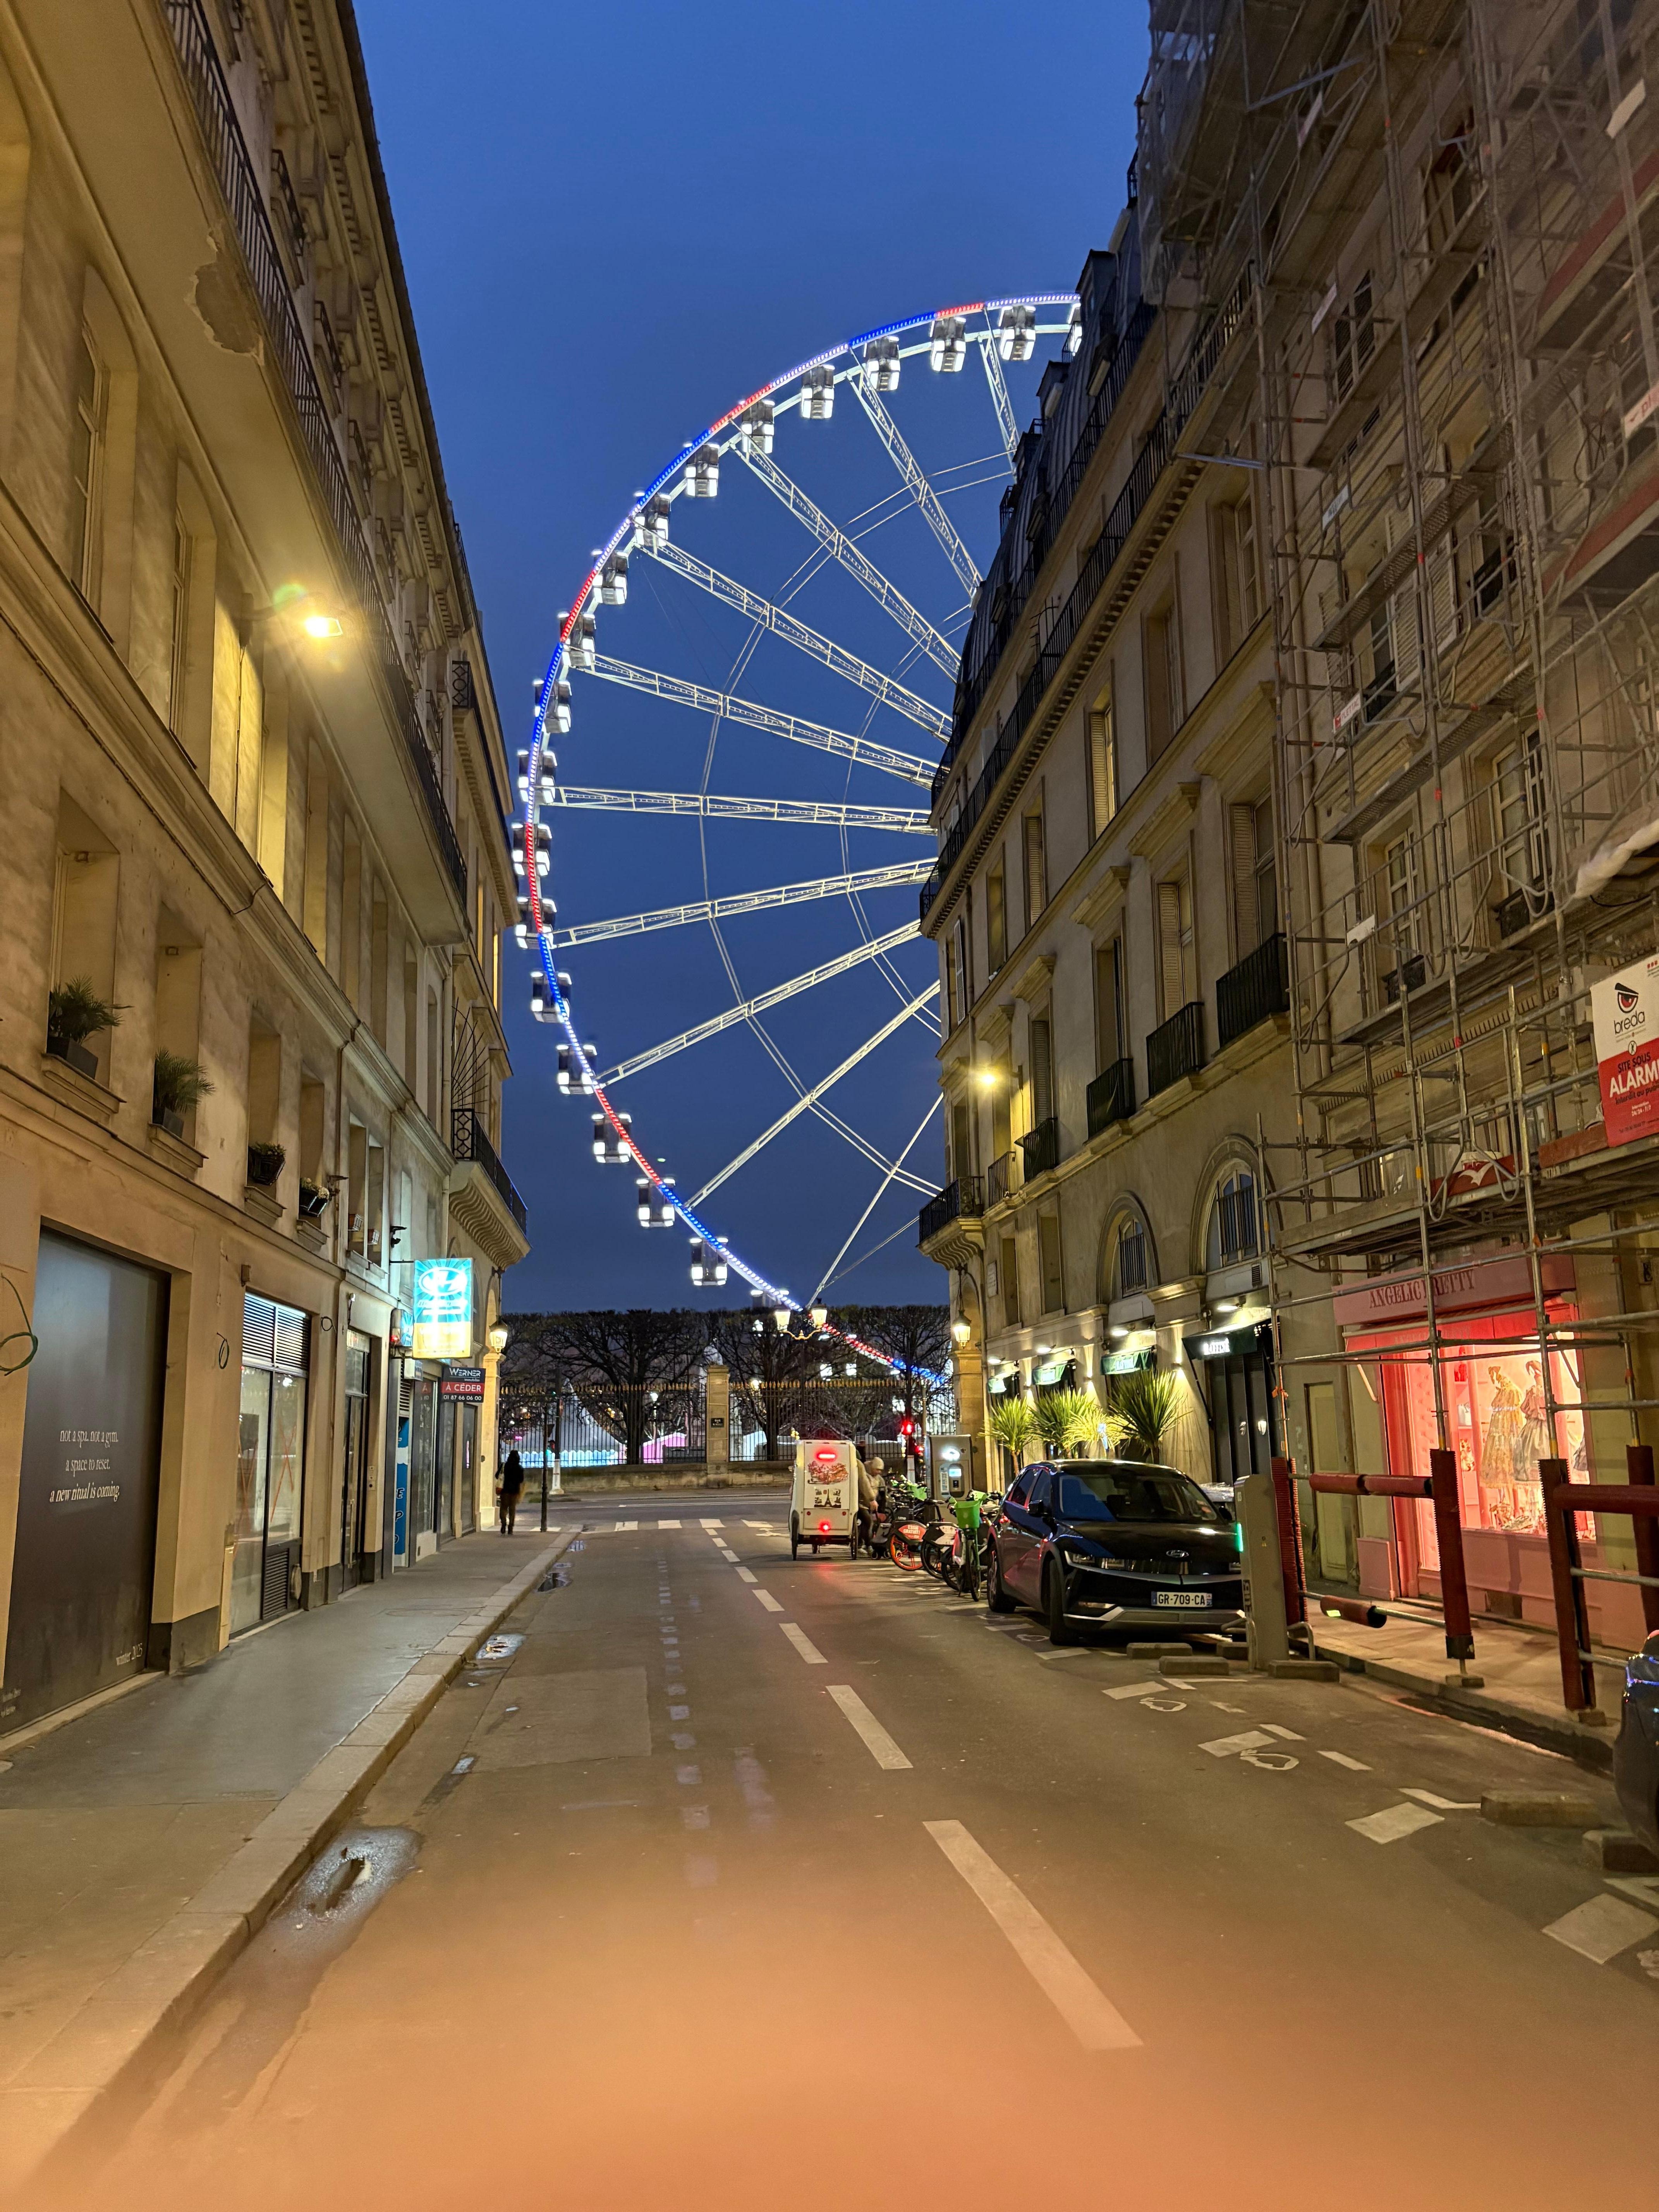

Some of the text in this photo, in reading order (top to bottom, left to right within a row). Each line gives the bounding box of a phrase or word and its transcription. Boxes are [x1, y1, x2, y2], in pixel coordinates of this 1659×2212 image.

[1614, 1010, 1645, 1035] breda
[1618, 1052, 1651, 1073] SITE SOUS
[1615, 1090, 1636, 1105] Interdit
[1370, 1281, 1421, 1309] ANGELIC
[454, 1382, 481, 1392] CÉDER
[60, 1429, 118, 1448] not a spa. not a gym.
[65, 1458, 110, 1477] a space to reset.
[50, 1491, 54, 1502] a
[56, 1489, 71, 1502] new
[71, 1482, 90, 1501] ritual
[90, 1482, 96, 1499] is
[1159, 1594, 1205, 1605] GR-709-CA
